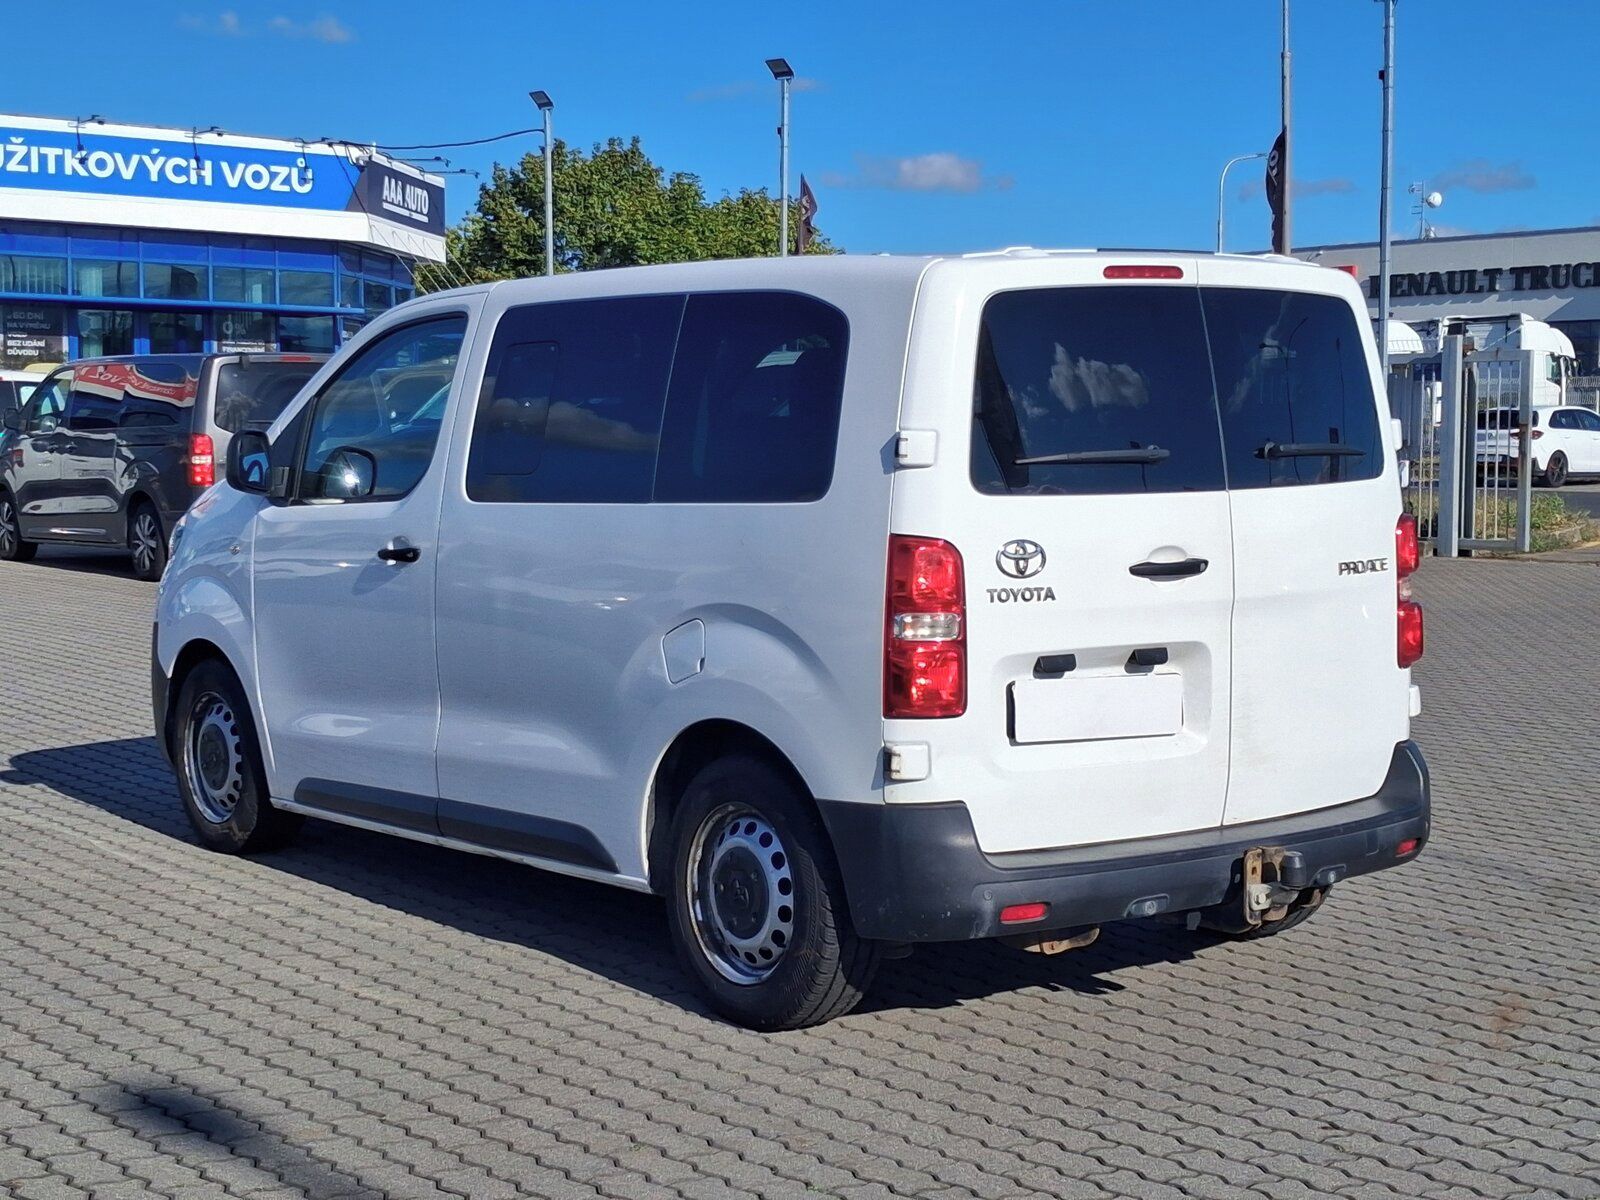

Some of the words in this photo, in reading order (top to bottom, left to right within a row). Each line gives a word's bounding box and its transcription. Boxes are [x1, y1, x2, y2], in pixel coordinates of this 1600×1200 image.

[0, 136, 213, 186] ŽITKOVÝCH
[220, 157, 314, 194] VOZŮ
[382, 175, 403, 206] AAA
[404, 184, 429, 215] AUTO
[986, 586, 1056, 603] TOYOTA
